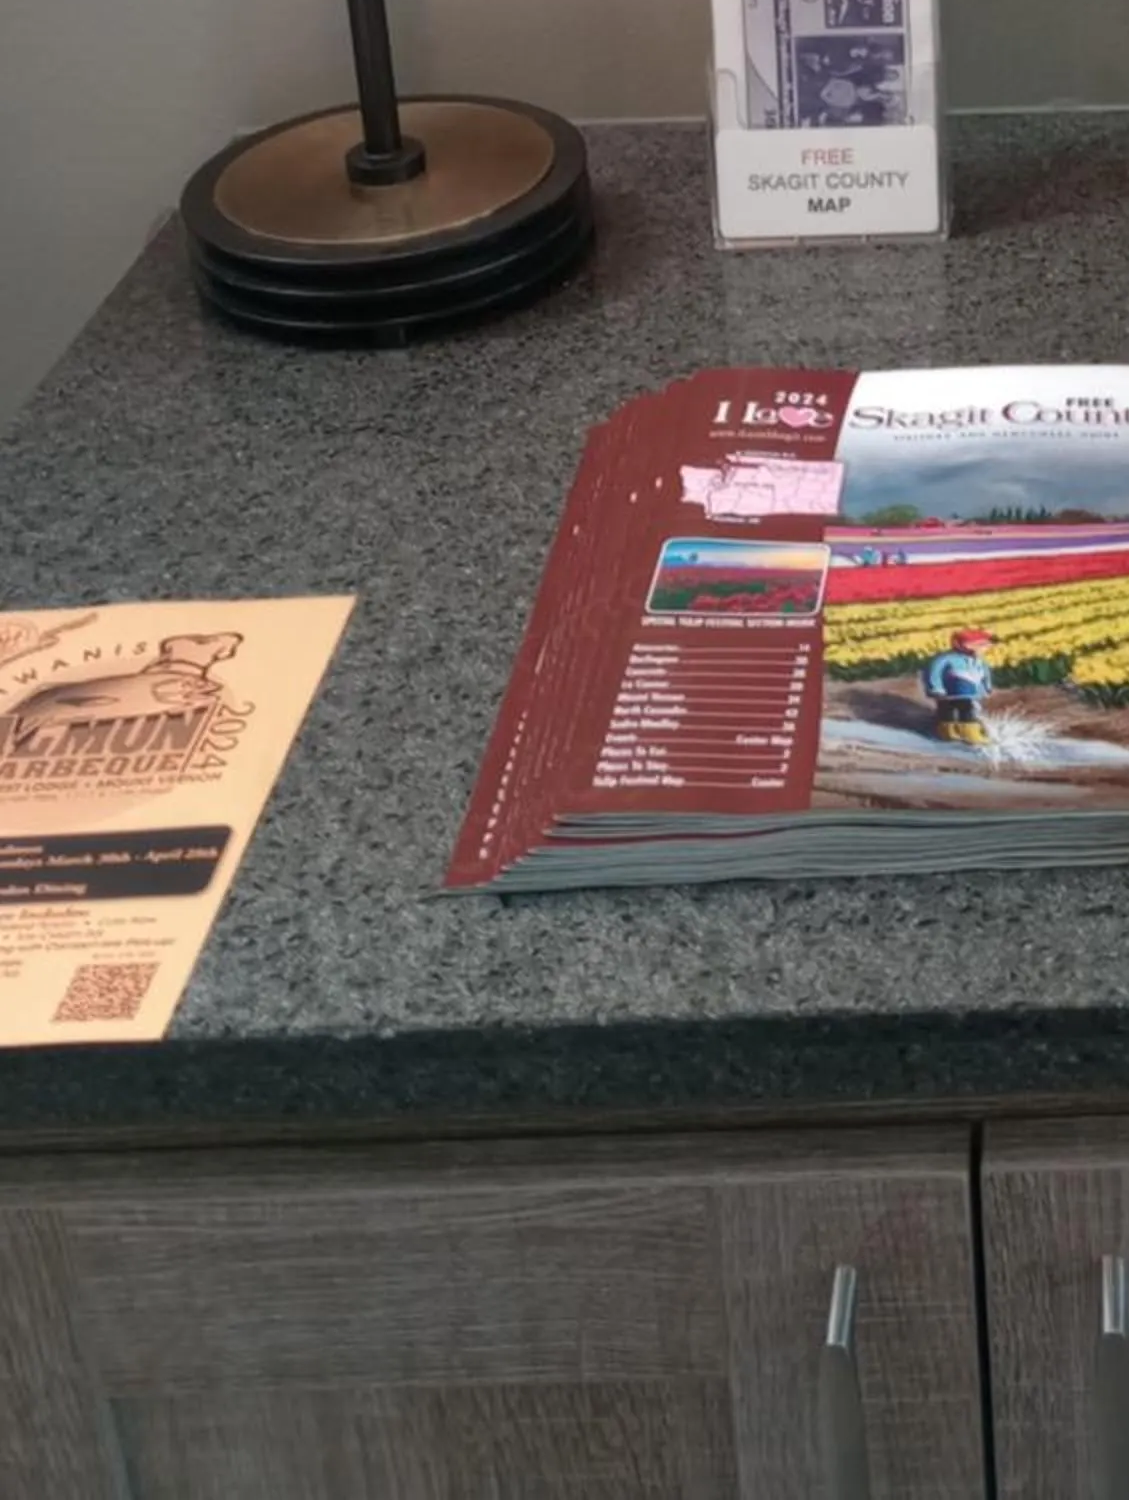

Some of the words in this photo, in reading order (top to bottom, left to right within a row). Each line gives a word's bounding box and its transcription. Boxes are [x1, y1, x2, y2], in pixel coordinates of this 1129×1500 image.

[800, 148, 855, 165] FREE
[747, 173, 820, 191] SKAGIT
[825, 171, 909, 190] COUNTY
[806, 197, 851, 213] MAP
[774, 390, 828, 406] 2024
[1065, 396, 1114, 408] FREE
[712, 400, 731, 424] I
[848, 403, 994, 431] Skagit
[192, 700, 256, 770] 2024
